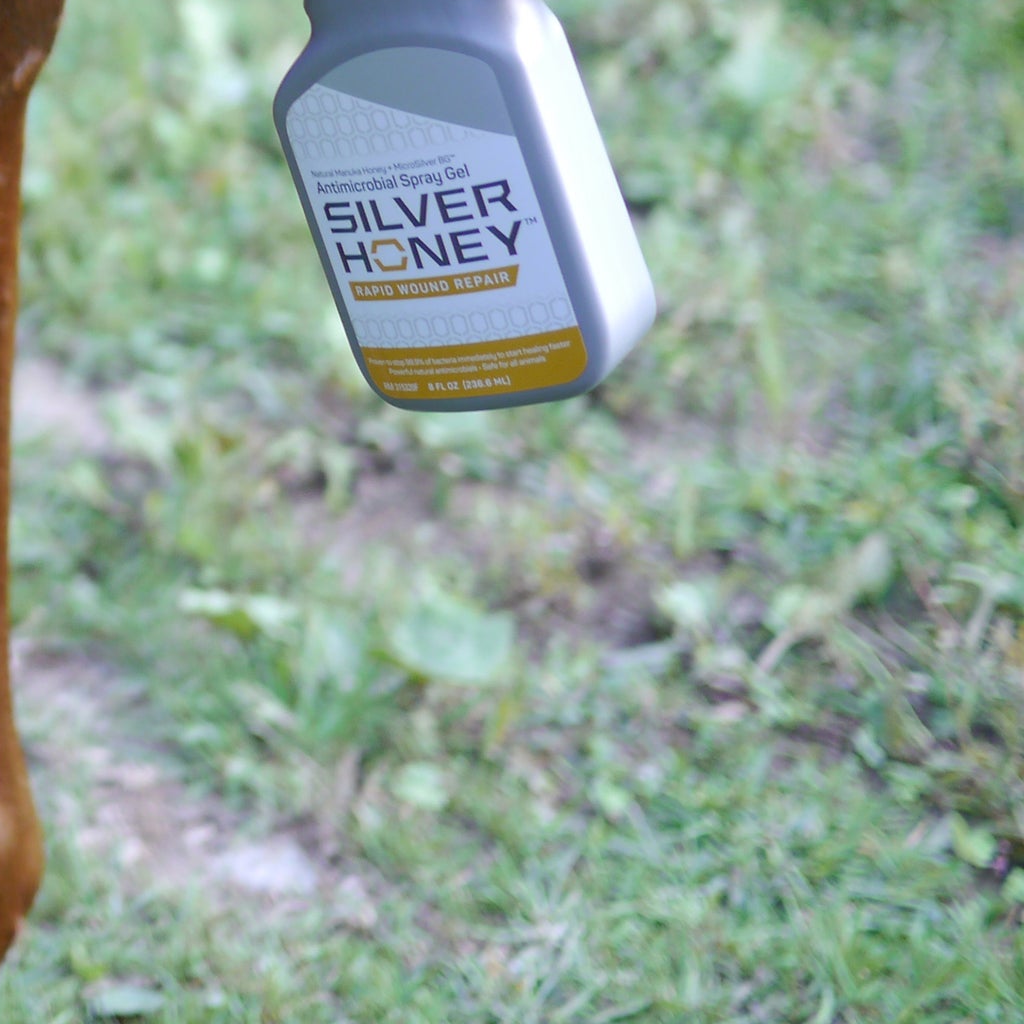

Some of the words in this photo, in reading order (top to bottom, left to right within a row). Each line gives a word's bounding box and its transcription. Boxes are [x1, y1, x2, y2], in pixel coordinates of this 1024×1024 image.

[317, 174, 398, 194] Antimicrobial
[400, 171, 443, 190] Spray
[445, 164, 471, 180] Gel
[362, 165, 387, 175] Honey
[393, 158, 437, 170] MicroSilver
[323, 179, 518, 234] SILVER
[355, 284, 394, 297] RAPID
[397, 280, 450, 295] WOUND
[454, 271, 511, 289] REPAIR
[436, 382, 447, 390] FL
[447, 381, 460, 390] OZ
